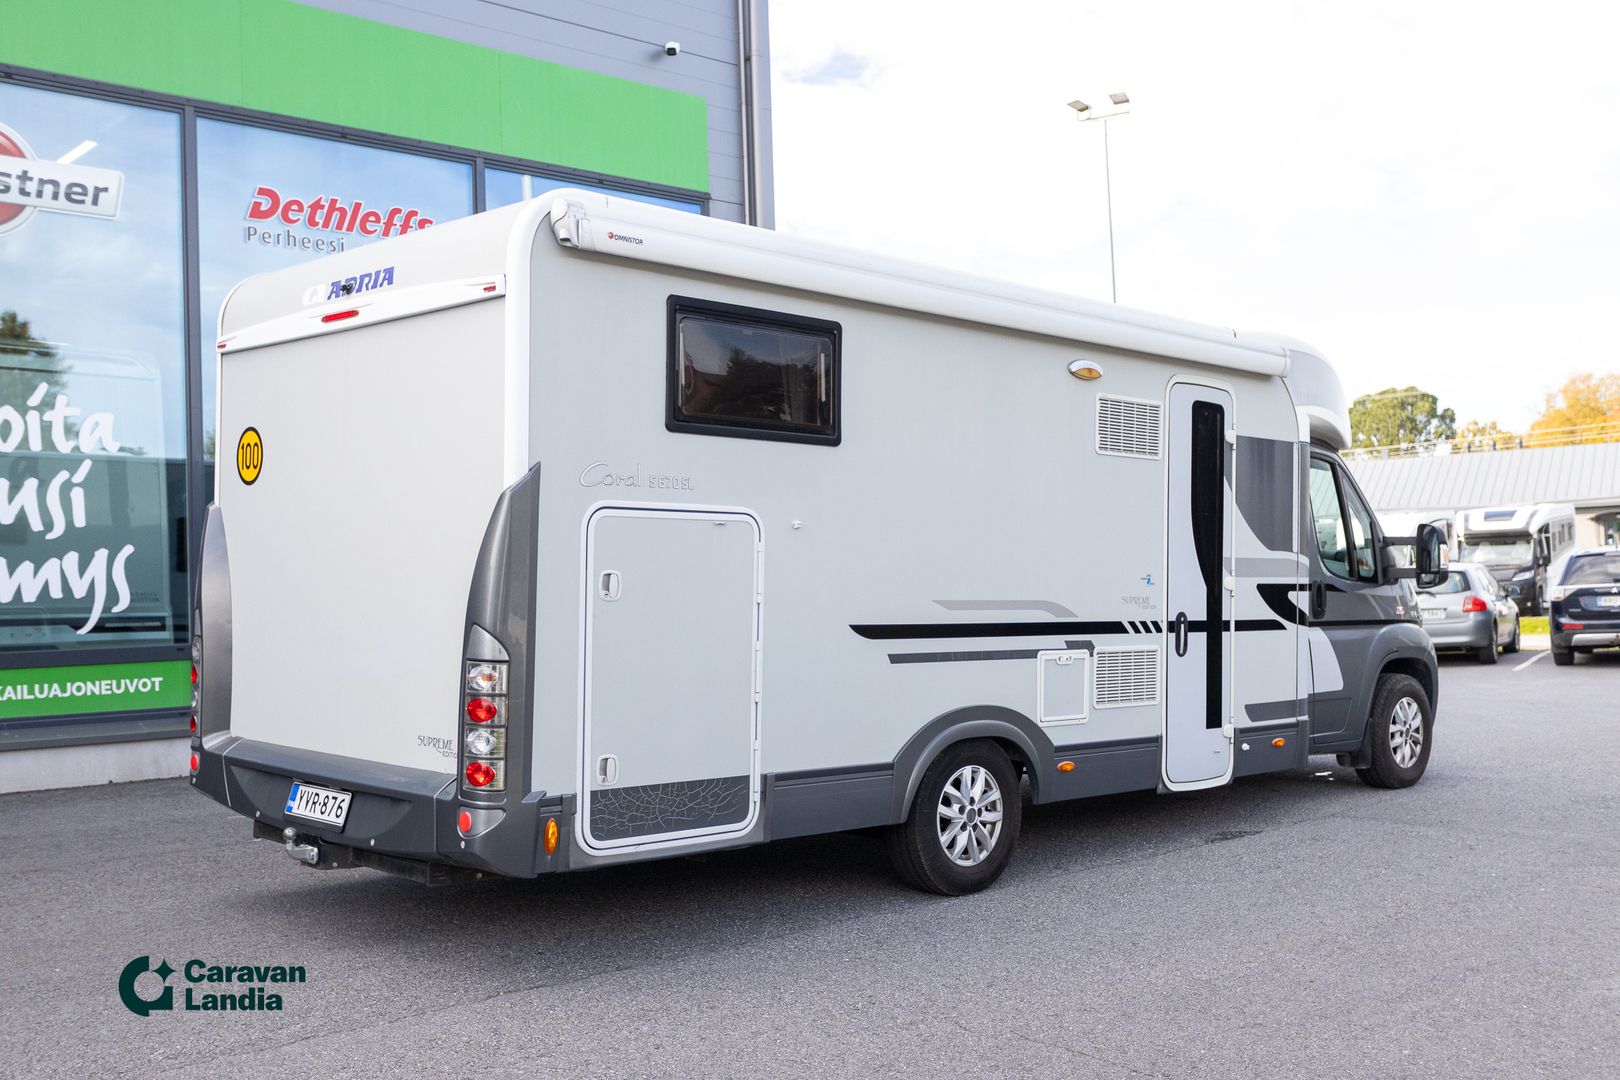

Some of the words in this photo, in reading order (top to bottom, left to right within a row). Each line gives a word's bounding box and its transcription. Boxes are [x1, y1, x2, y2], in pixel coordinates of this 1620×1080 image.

[247, 226, 345, 253] Perheesi
[614, 234, 644, 246] OMNISTOR
[241, 442, 259, 470] 100
[580, 461, 641, 488] Coral
[417, 735, 454, 751] SUPREME
[297, 789, 346, 819] YVR-876
